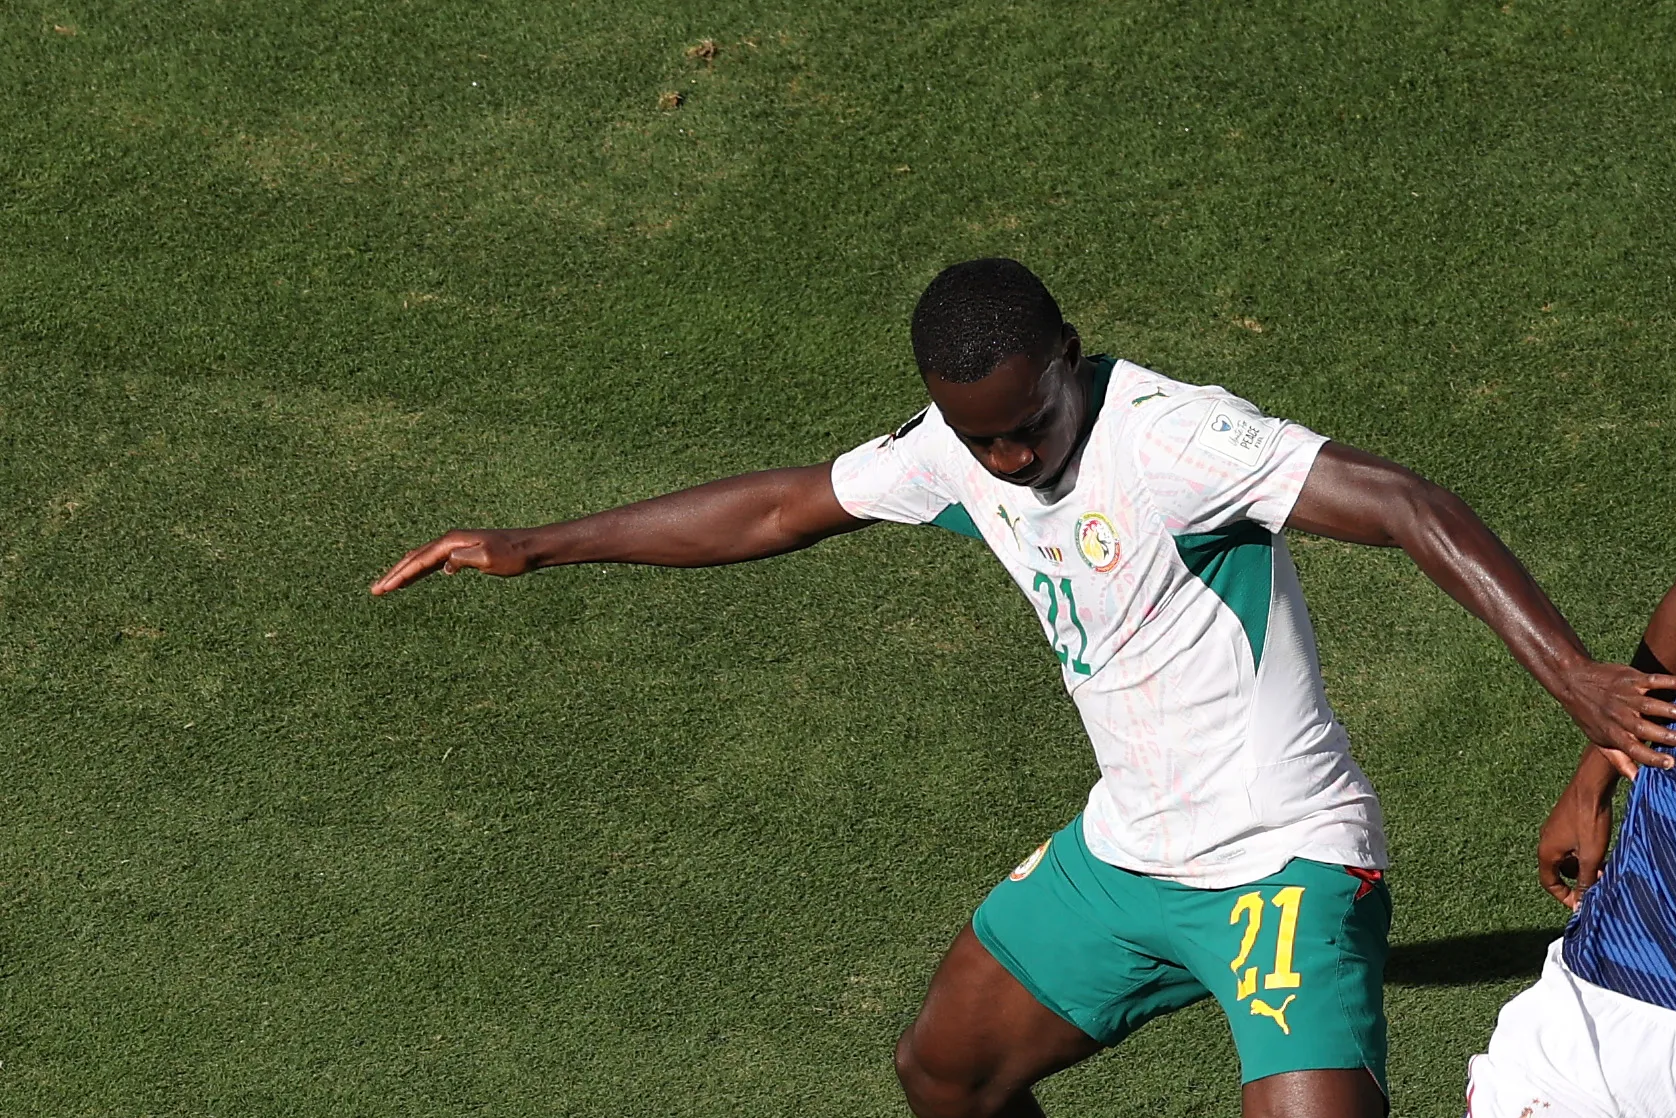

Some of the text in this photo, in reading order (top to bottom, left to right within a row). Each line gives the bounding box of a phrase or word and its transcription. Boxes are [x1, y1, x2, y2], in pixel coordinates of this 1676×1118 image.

[1240, 425, 1260, 450] PEACE
[1033, 571, 1092, 676] 21
[1230, 886, 1306, 1001] 21
